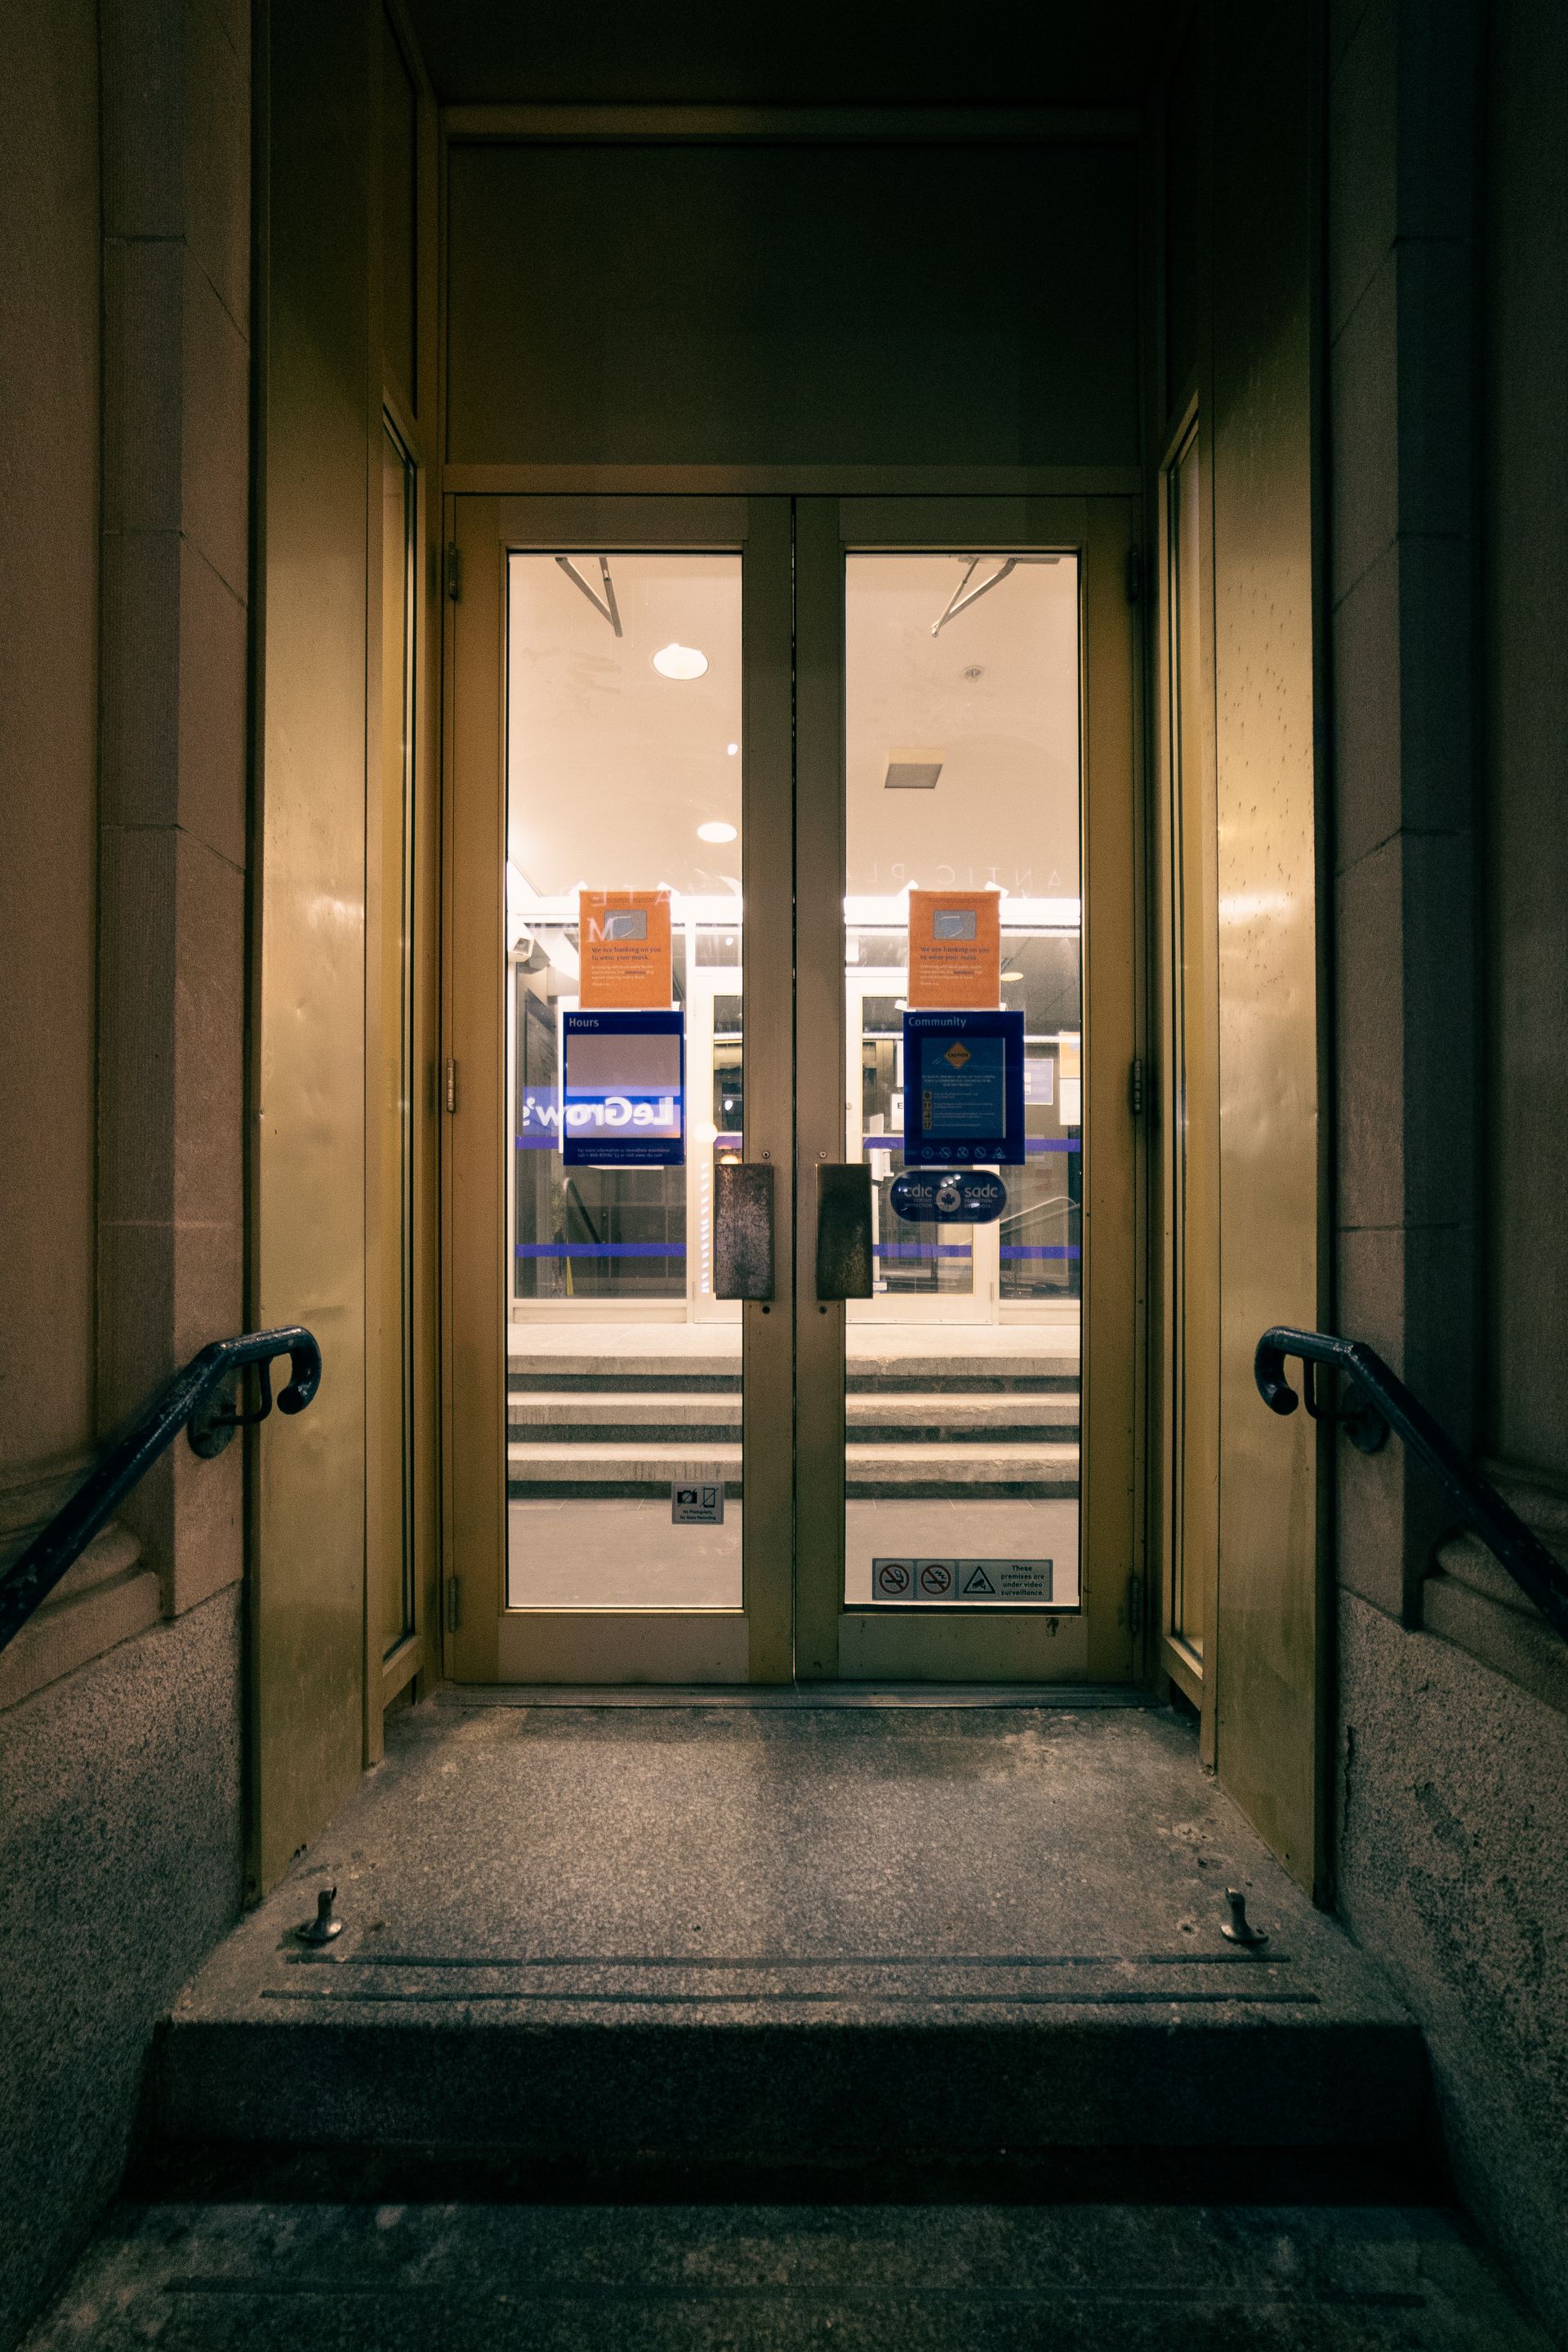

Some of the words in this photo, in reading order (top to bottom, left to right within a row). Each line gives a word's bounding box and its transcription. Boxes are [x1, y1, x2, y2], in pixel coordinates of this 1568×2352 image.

[568, 1018, 599, 1028] Hours
[908, 1017, 967, 1029] Community
[903, 1183, 933, 1198] cdic
[964, 1183, 999, 1199] sadc
